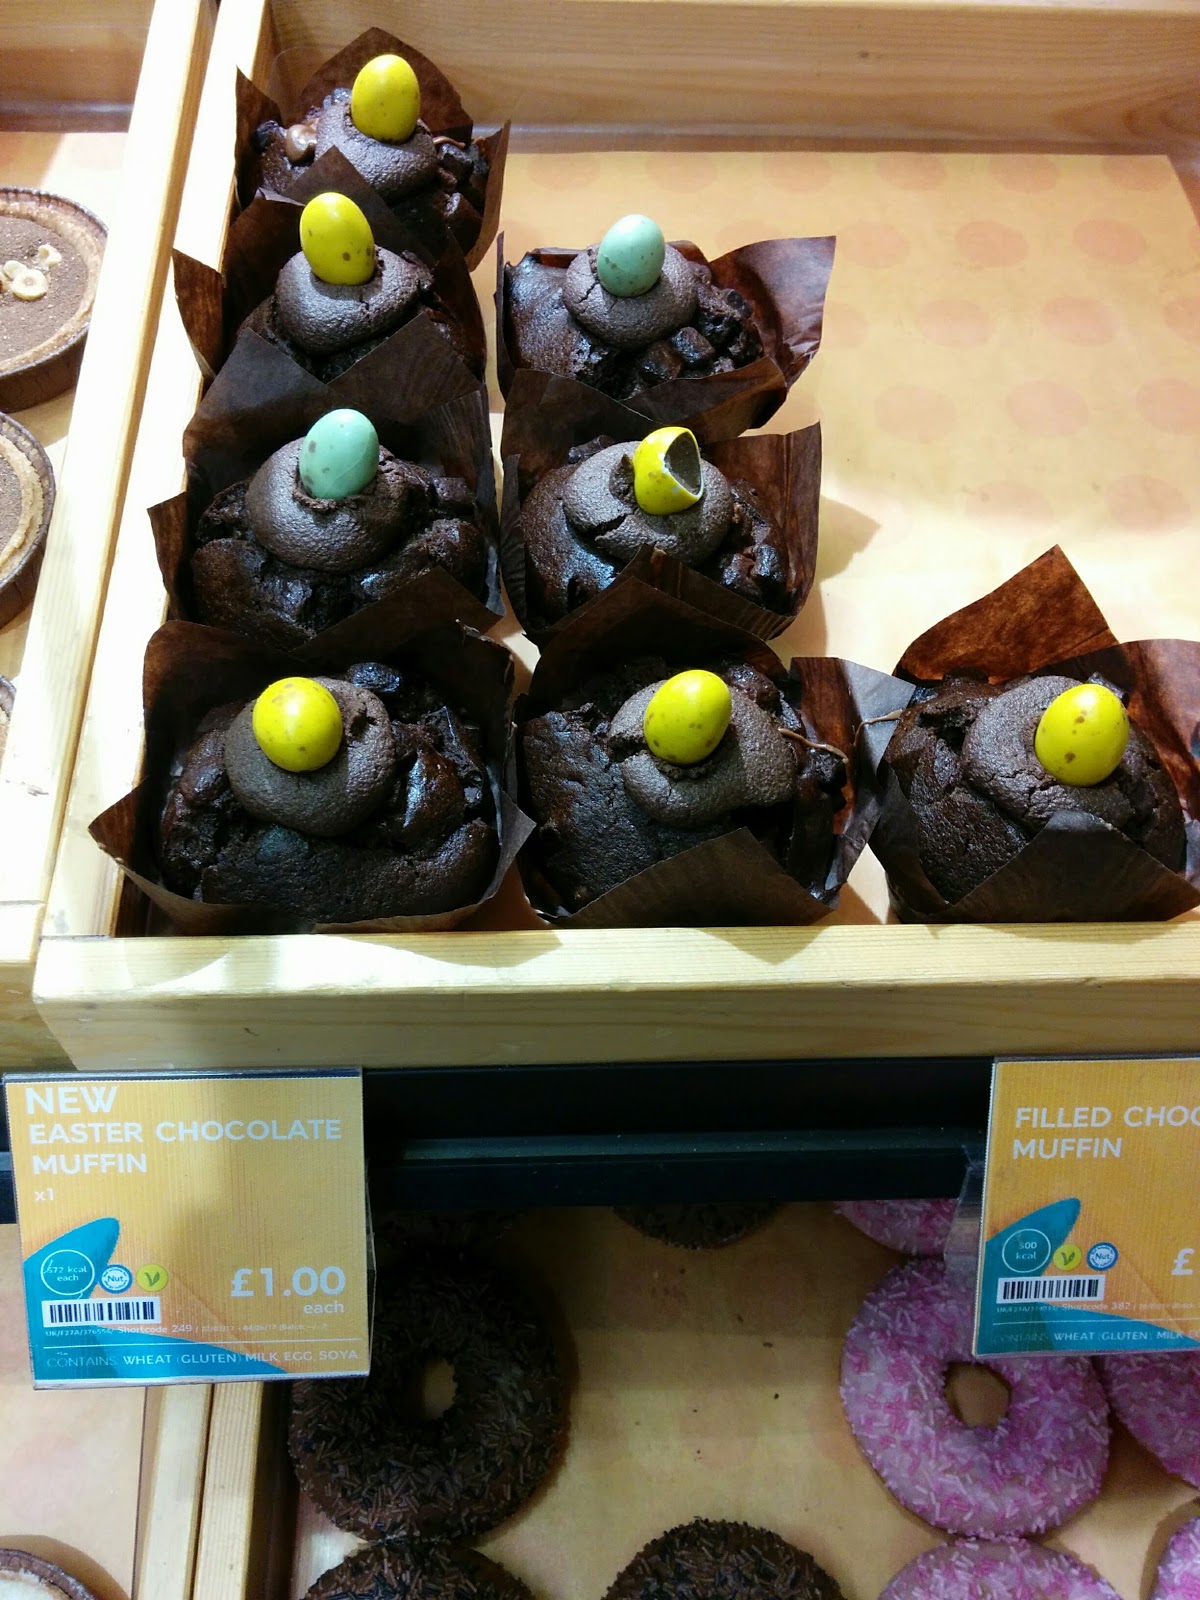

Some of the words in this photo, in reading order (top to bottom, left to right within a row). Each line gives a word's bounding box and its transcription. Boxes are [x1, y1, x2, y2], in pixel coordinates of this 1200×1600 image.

[25, 1086, 118, 1114] NEW
[1015, 1107, 1112, 1128] FILLED
[30, 1122, 144, 1144] EASTER
[155, 1118, 342, 1142] CHOCOLATE
[1012, 1137, 1122, 1160] MUFFIN
[32, 1152, 148, 1175] MUFFIN
[35, 1187, 54, 1201] x1
[1015, 1251, 1037, 1260] kcal
[1095, 1252, 1111, 1260] Nut
[67, 1265, 88, 1273] kcal
[56, 1274, 79, 1282] each
[230, 1266, 346, 1297] £1.00
[303, 1301, 344, 1314] each
[117, 1325, 168, 1335] Shortcode
[172, 1324, 192, 1334] 249
[1053, 1331, 1095, 1341] WHEAT
[122, 1354, 172, 1366] WHEAT
[319, 1350, 358, 1361] SOYA
